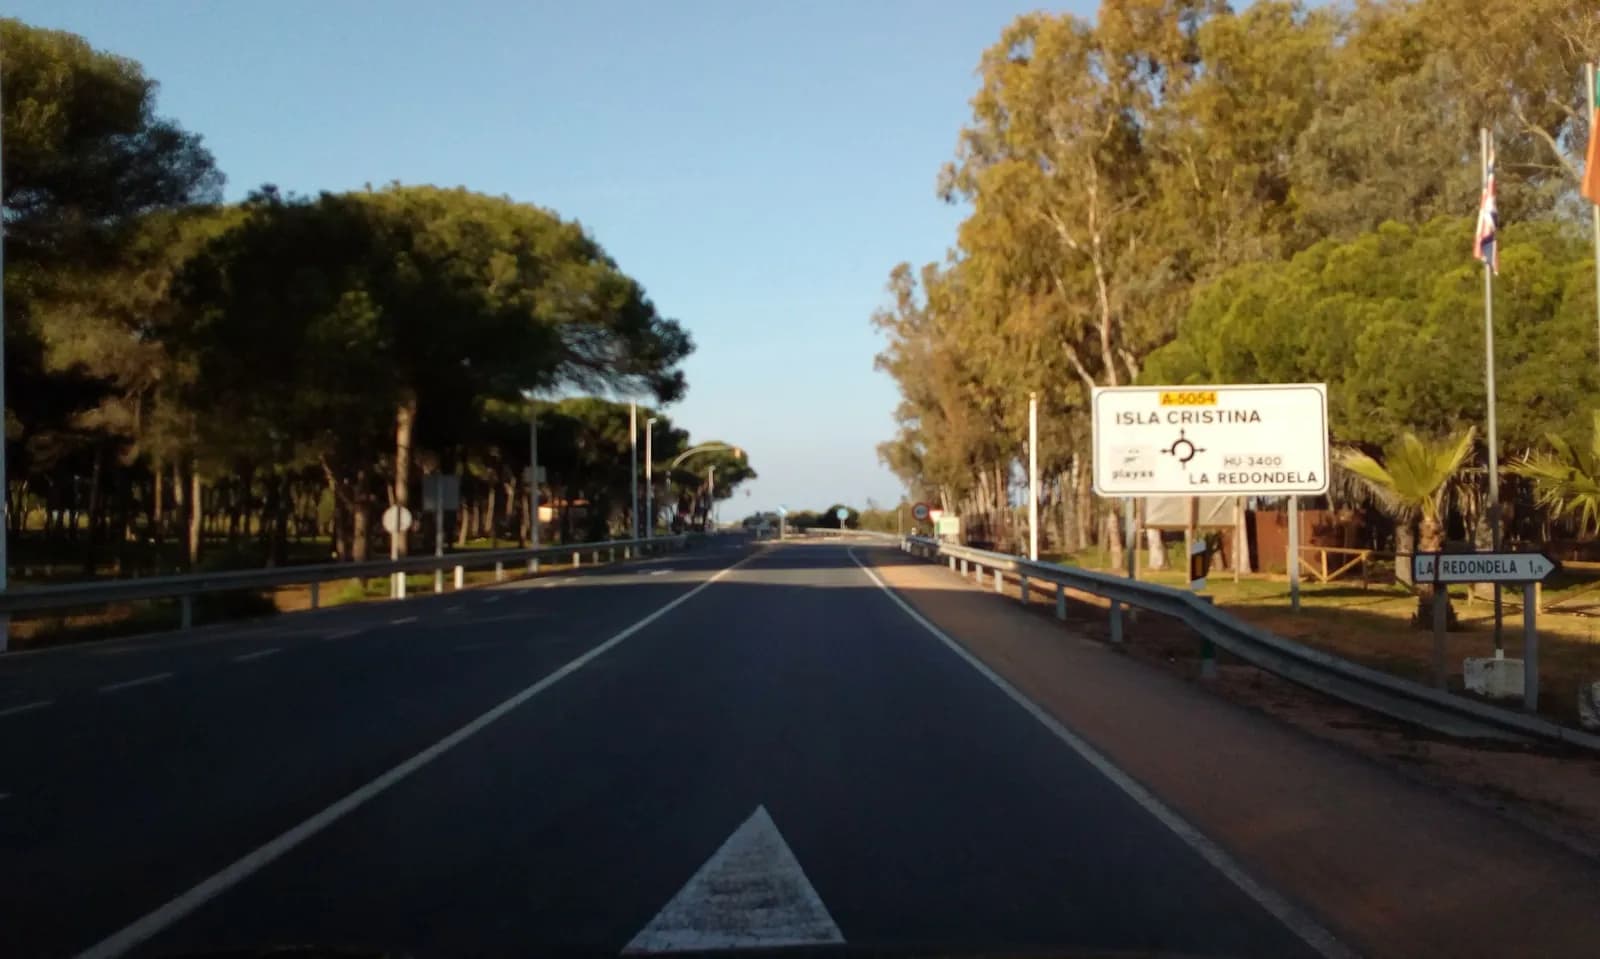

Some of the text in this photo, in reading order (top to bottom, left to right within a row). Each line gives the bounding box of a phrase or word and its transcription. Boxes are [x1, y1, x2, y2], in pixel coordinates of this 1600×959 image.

[1116, 410, 1261, 425] ISLA CRISTINA
[1189, 471, 1317, 485] LA REDONDELA
[1418, 560, 1434, 575] LA
[1443, 559, 1517, 574] REDONDELA
